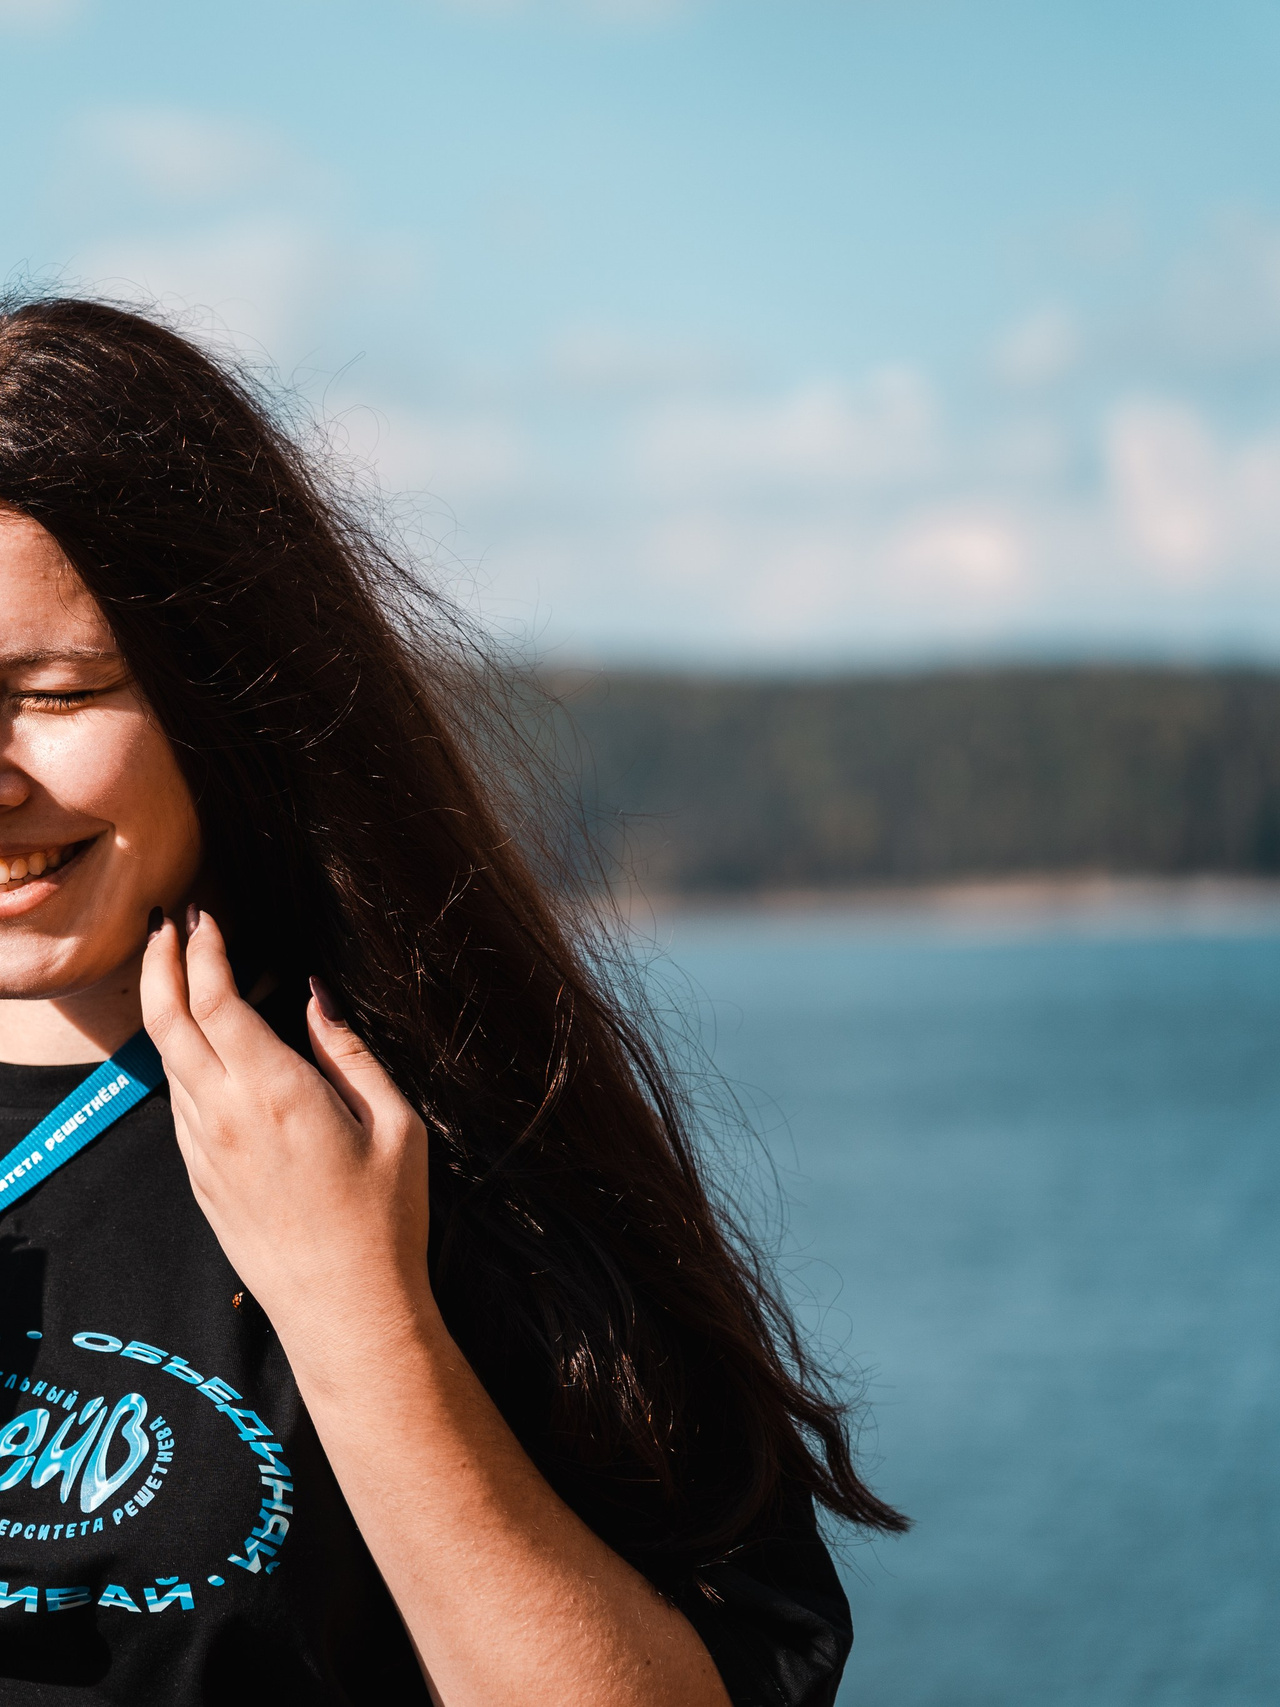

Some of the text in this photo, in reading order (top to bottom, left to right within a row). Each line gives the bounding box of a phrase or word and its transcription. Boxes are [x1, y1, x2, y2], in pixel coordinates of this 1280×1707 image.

[44, 1073, 130, 1152] РЕШЕТНЁВА
[72, 1332, 294, 1575] ОБЪЕДИНЯЙ
[111, 1415, 175, 1526] РЕШЕТНЕВА
